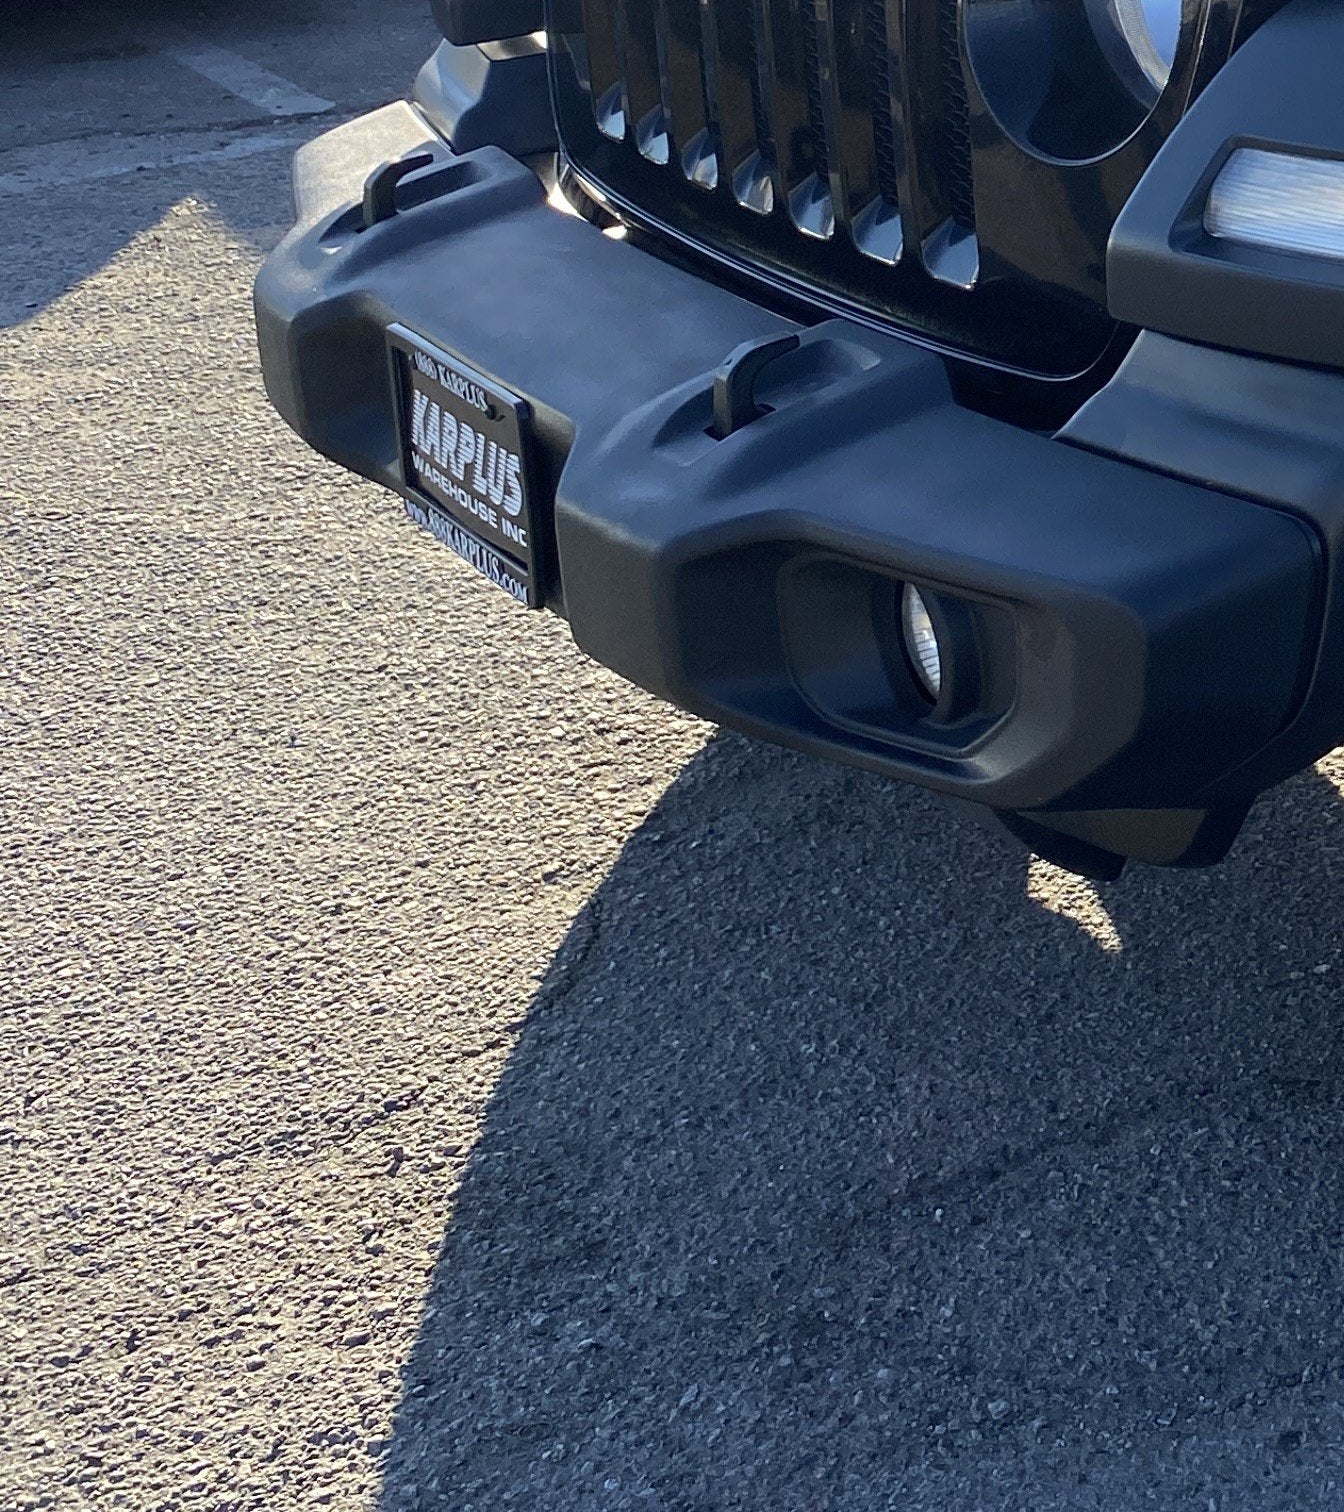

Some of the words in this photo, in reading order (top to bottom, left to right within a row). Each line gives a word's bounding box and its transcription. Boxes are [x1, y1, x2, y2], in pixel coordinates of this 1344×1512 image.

[437, 364, 488, 411] KARPLUS
[411, 389, 522, 516] KARPLUS
[411, 451, 497, 528] WAREHOUSE
[502, 517, 528, 547] INC
